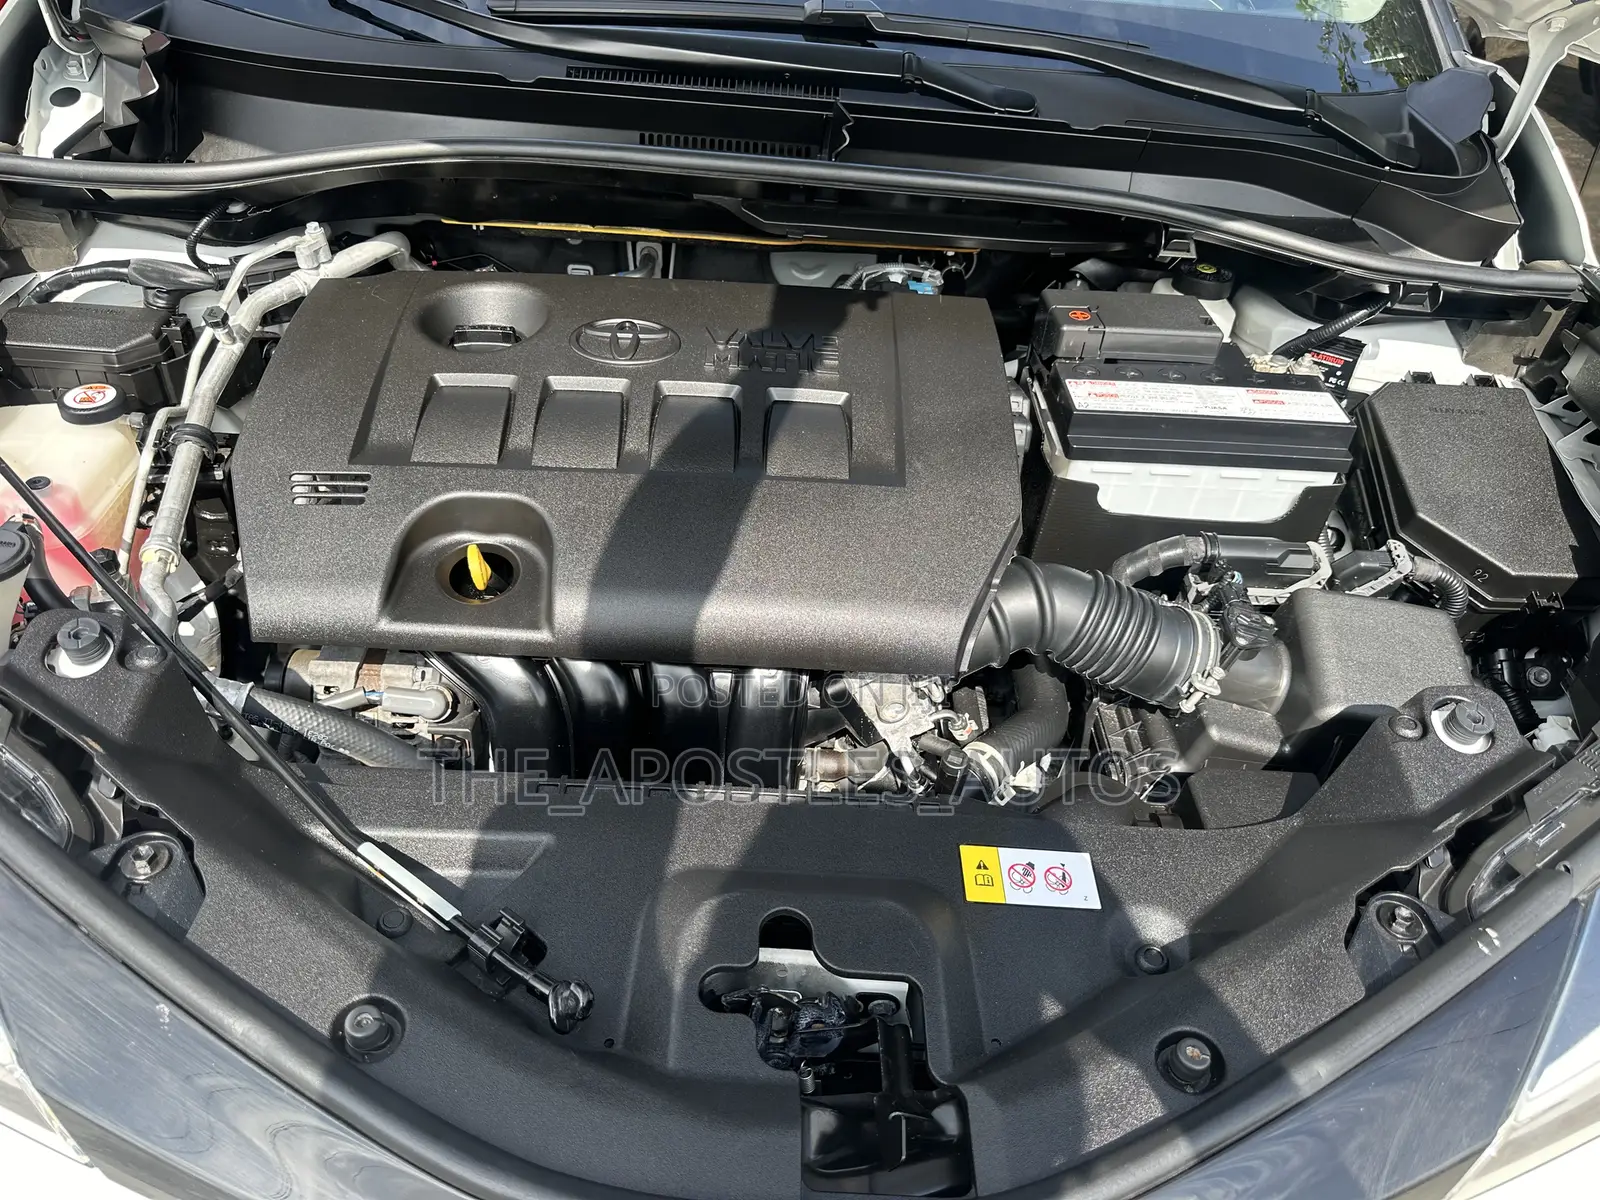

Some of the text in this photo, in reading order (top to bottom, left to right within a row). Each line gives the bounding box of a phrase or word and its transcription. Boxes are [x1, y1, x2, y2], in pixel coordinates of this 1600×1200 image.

[704, 326, 839, 352] VALVE
[704, 346, 839, 376] MATIC
[1473, 568, 1489, 583] 92
